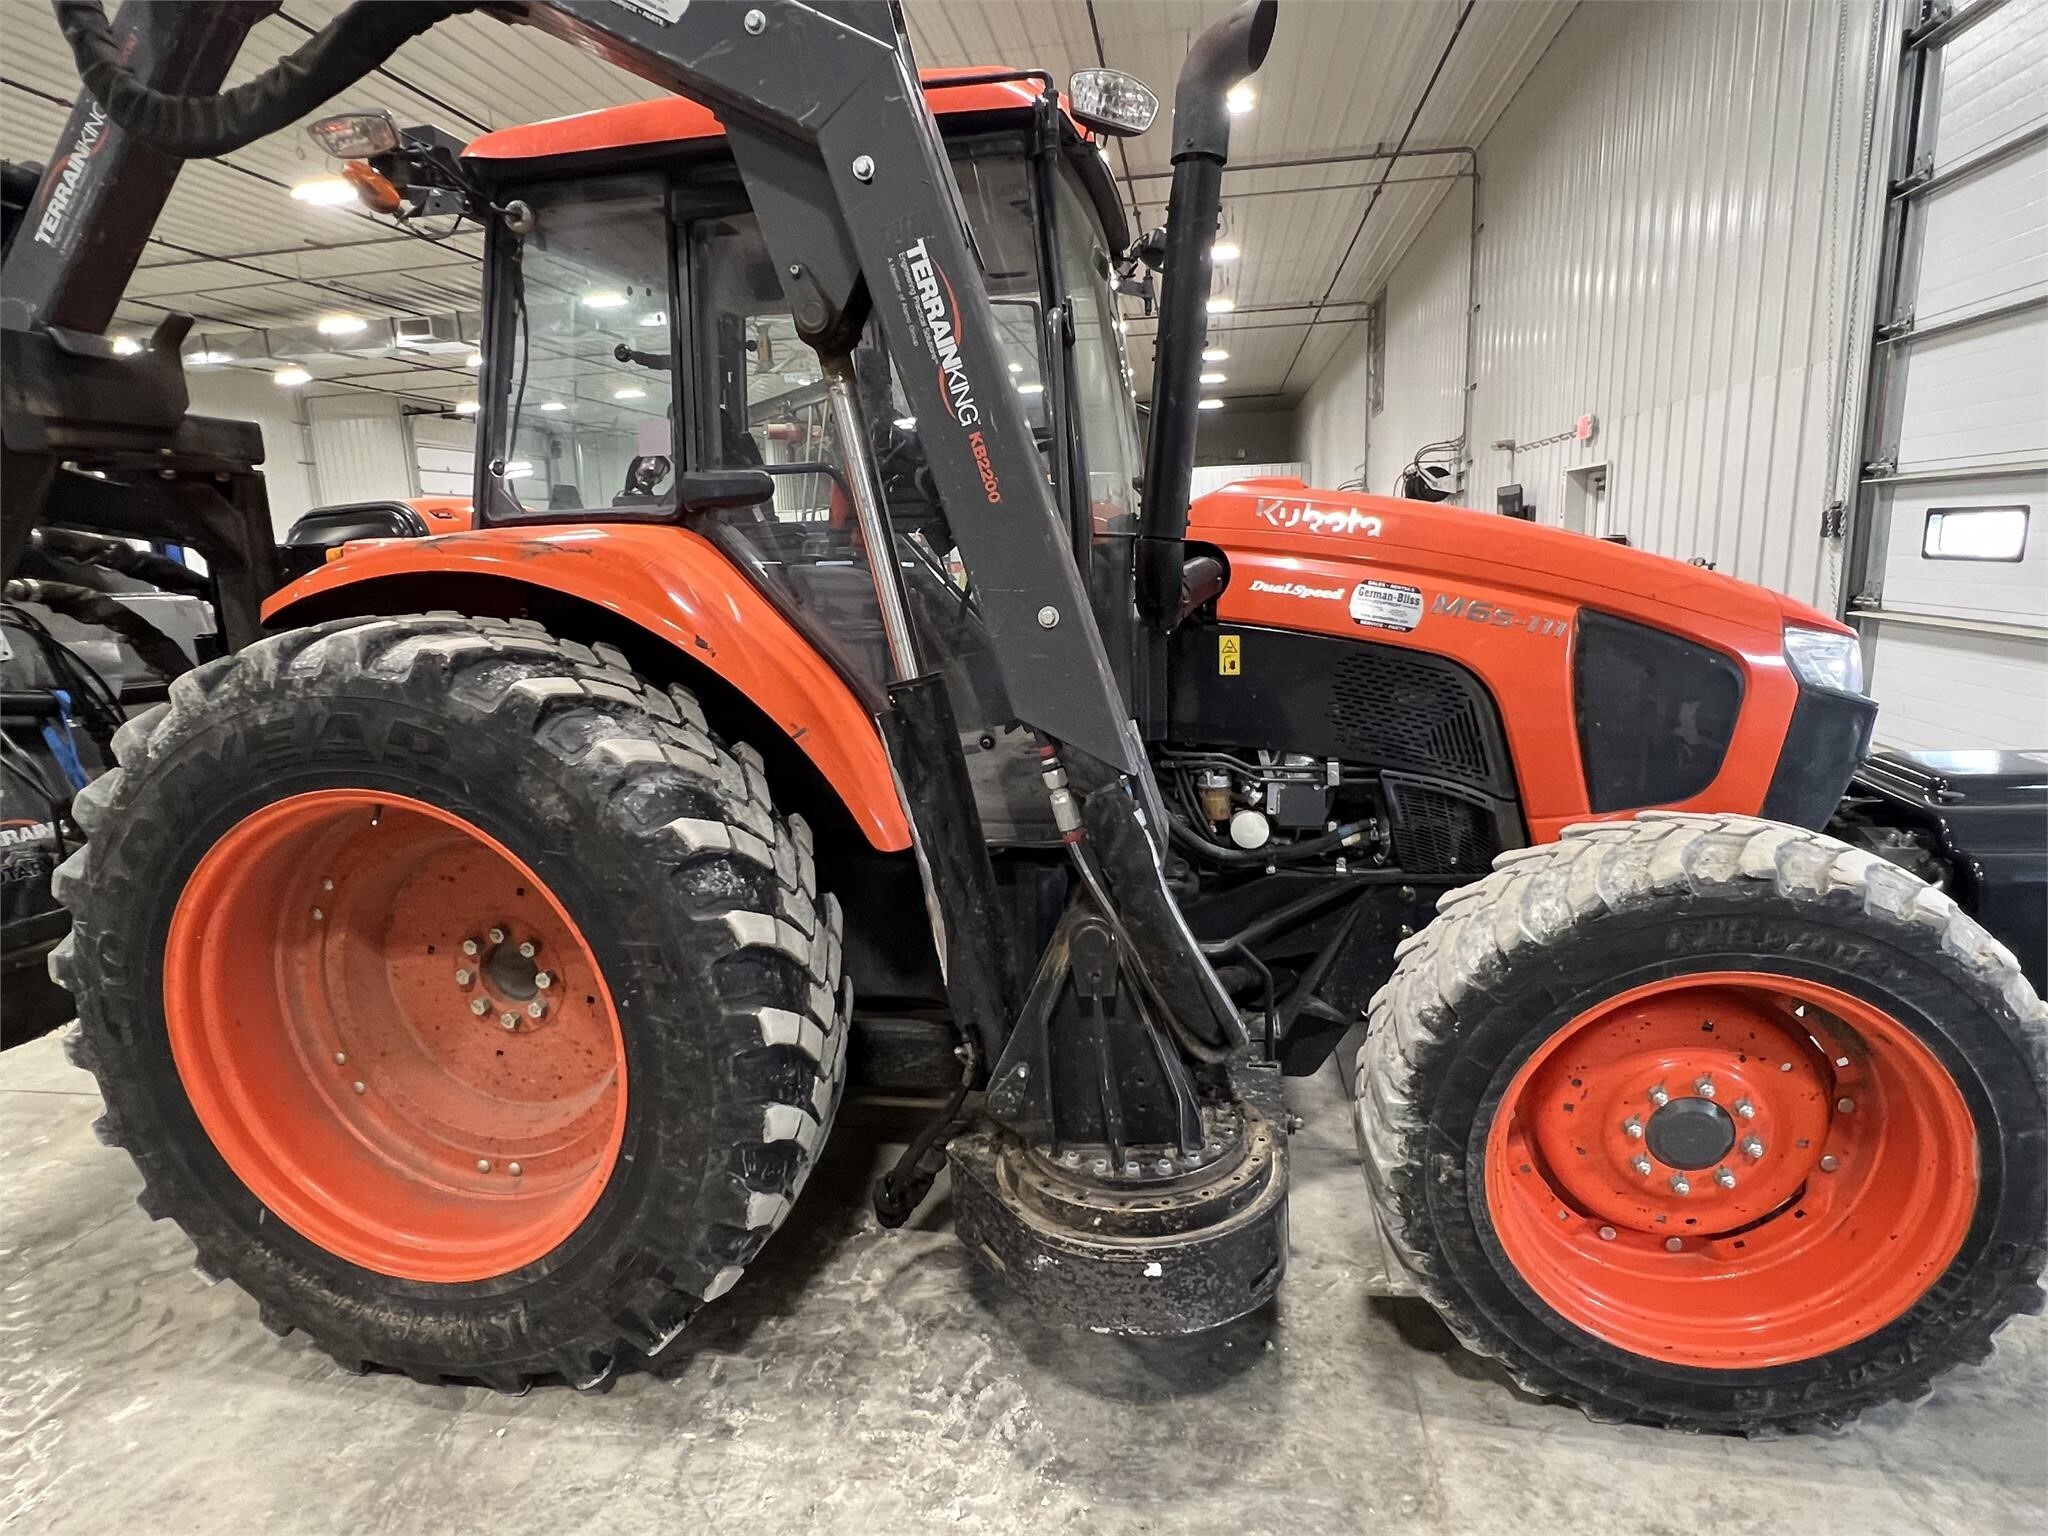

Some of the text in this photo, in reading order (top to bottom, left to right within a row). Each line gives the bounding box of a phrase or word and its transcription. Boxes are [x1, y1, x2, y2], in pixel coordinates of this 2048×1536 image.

[906, 238, 979, 427] TERRAINKING
[969, 431, 1001, 503] KB2200
[1256, 499, 1382, 538] Kubota
[1358, 586, 1420, 606] German-Bliss
